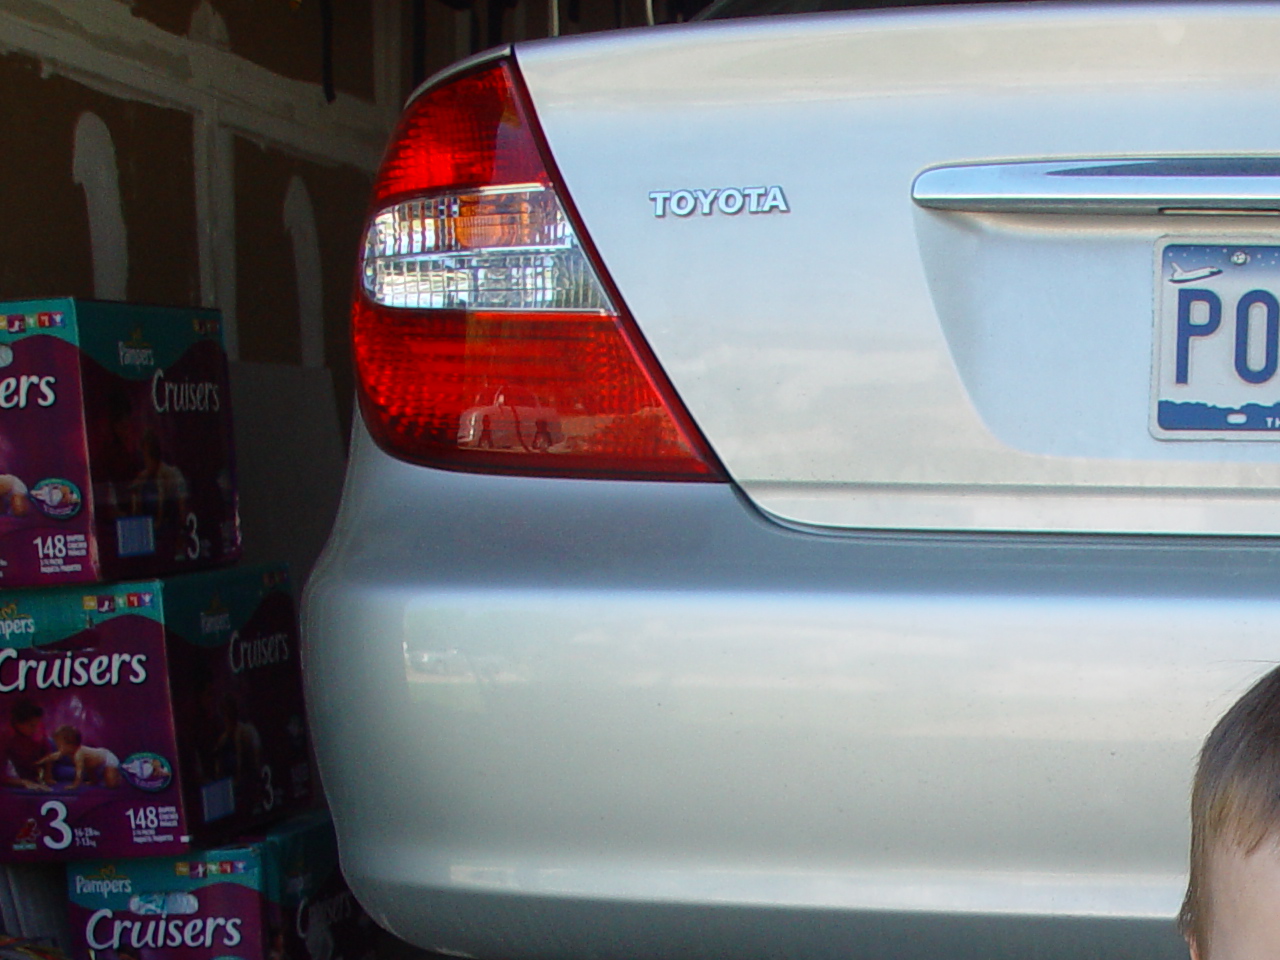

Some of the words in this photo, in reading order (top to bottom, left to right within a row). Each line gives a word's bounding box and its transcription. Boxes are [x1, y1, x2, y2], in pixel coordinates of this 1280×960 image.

[649, 185, 790, 218] TOYOTA
[150, 367, 220, 413] Cruisers
[33, 533, 67, 559] 148
[185, 512, 200, 560] 3
[0, 647, 148, 693] Cruisers
[228, 630, 289, 674] Cruisers
[40, 800, 73, 850] 3
[125, 806, 158, 829] 148
[75, 875, 132, 899] Pampers
[85, 908, 242, 950] Cruisers
